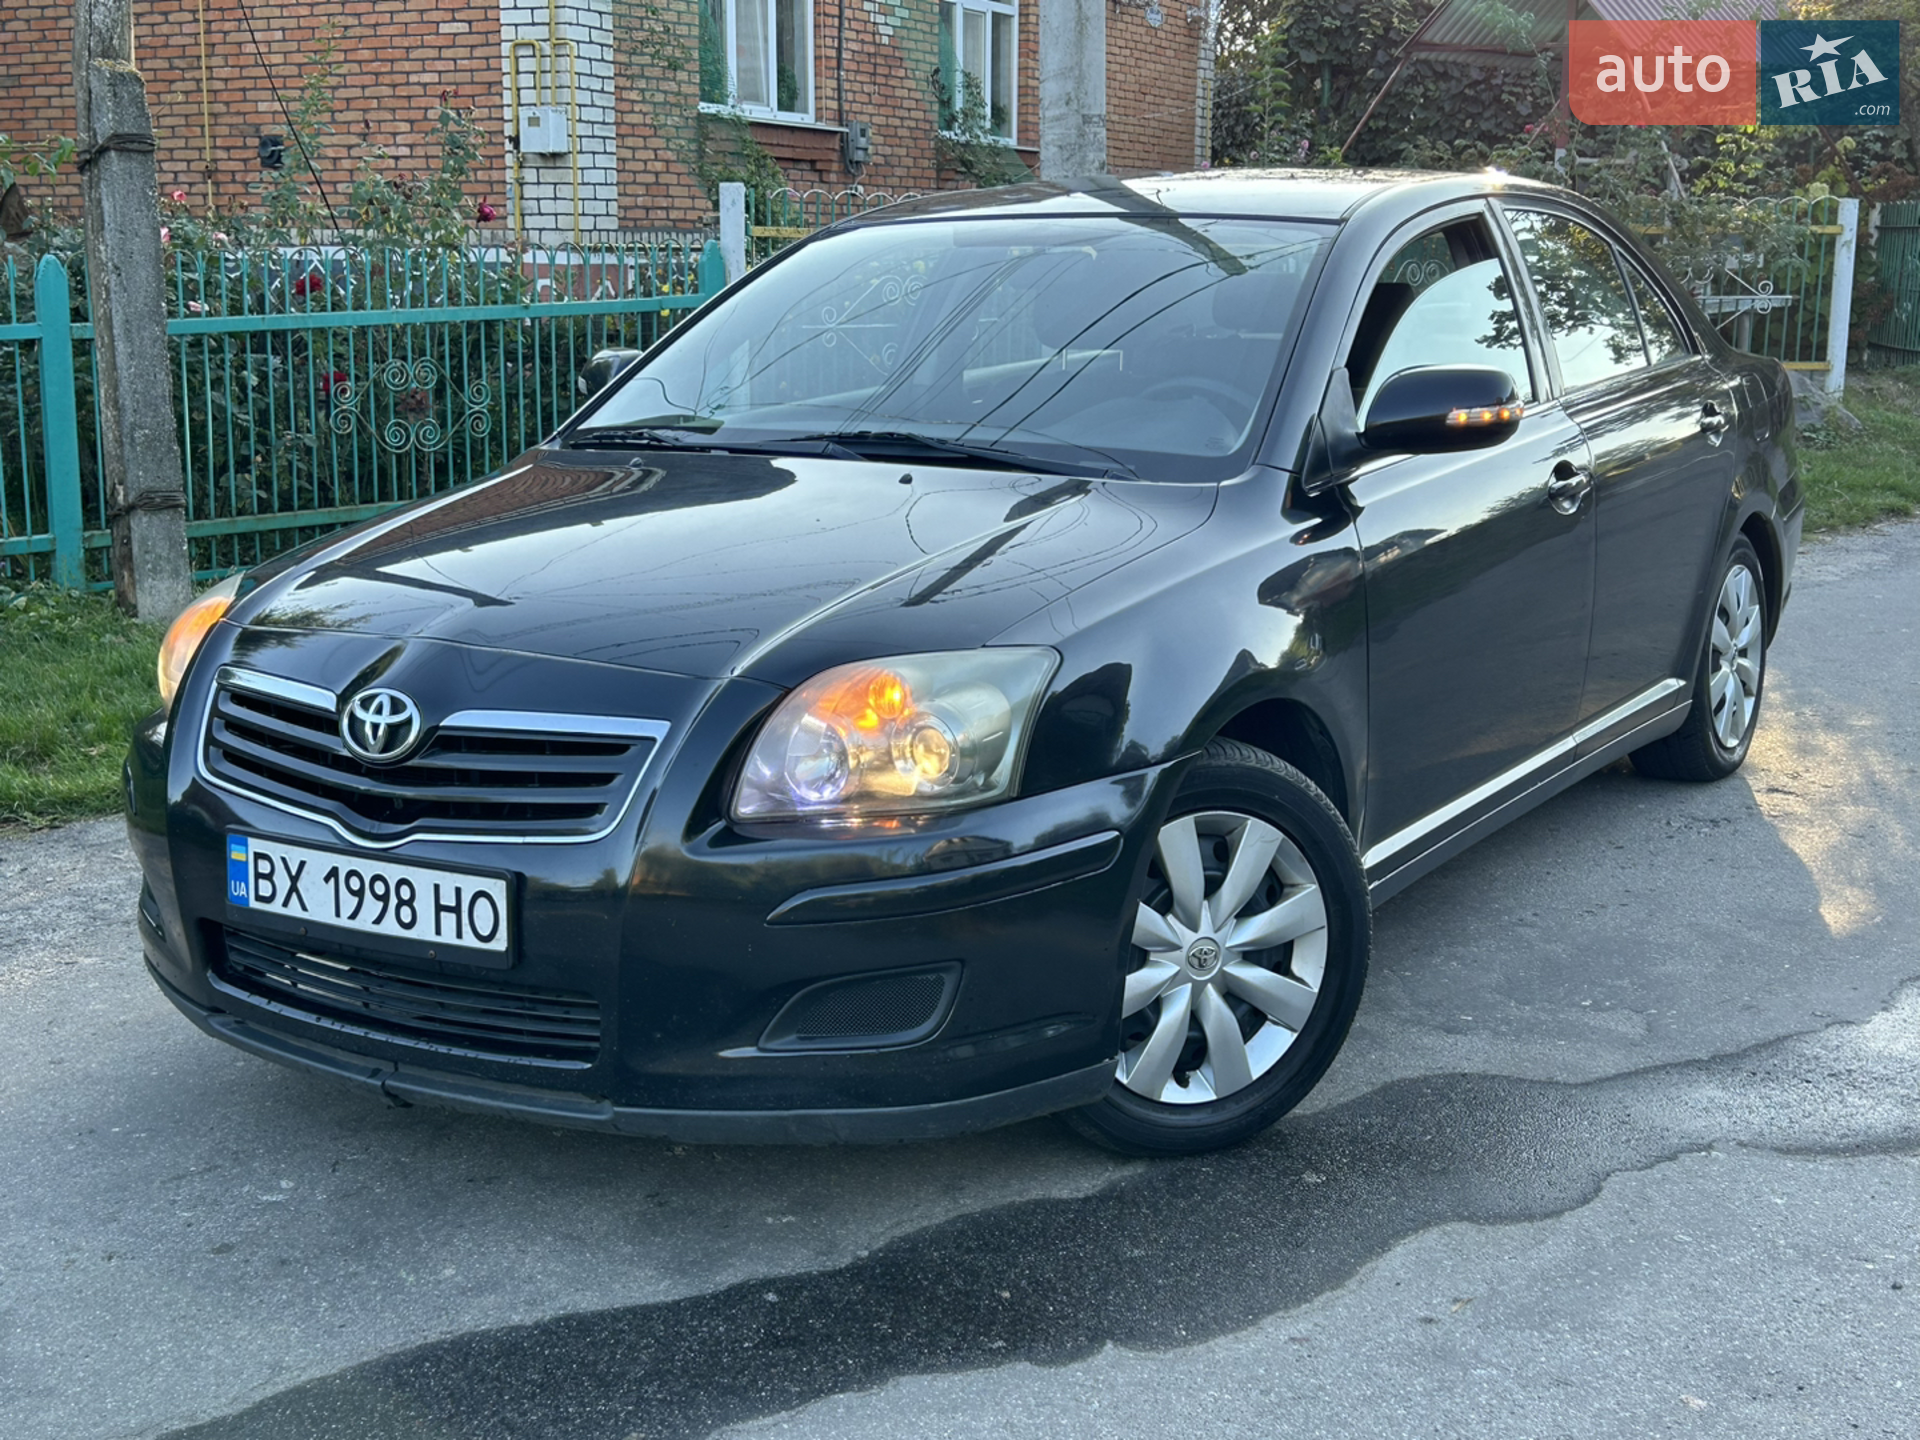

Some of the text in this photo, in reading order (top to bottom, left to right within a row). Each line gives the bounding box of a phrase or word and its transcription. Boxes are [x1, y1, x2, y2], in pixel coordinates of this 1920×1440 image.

[231, 881, 248, 898] UA
[253, 851, 499, 943] BX 1998 HO
